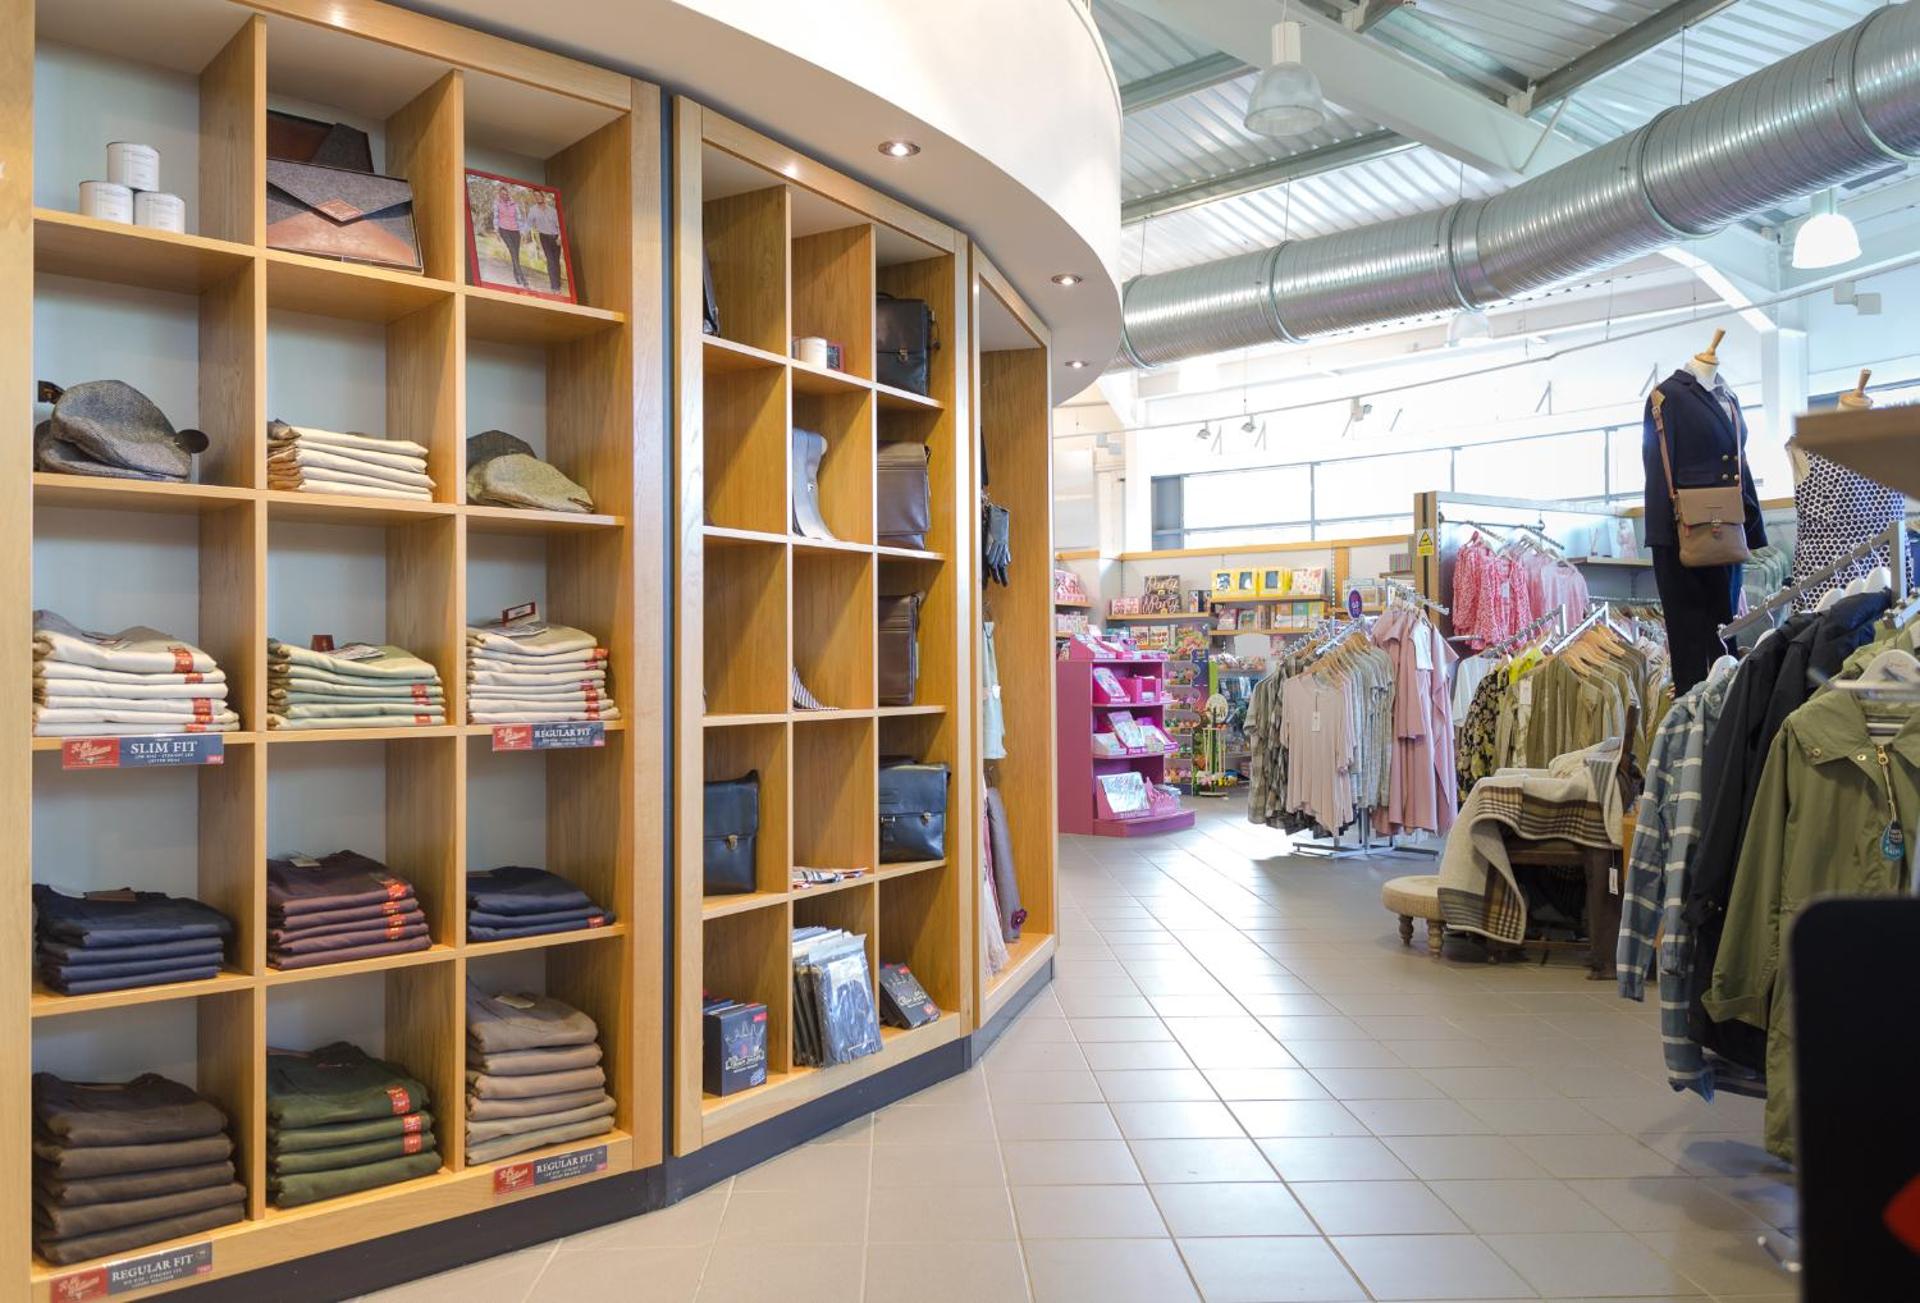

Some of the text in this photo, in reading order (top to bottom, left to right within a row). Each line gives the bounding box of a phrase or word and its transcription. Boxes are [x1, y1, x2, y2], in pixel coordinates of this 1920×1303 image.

[534, 728, 576, 738] REGULAR
[577, 727, 591, 736] FIT
[130, 741, 198, 755] SLIM FIT
[536, 1157, 578, 1174] REGULAR
[580, 1153, 593, 1164] FIT
[112, 1260, 171, 1282] REGULAR
[174, 1254, 194, 1267] FIT
